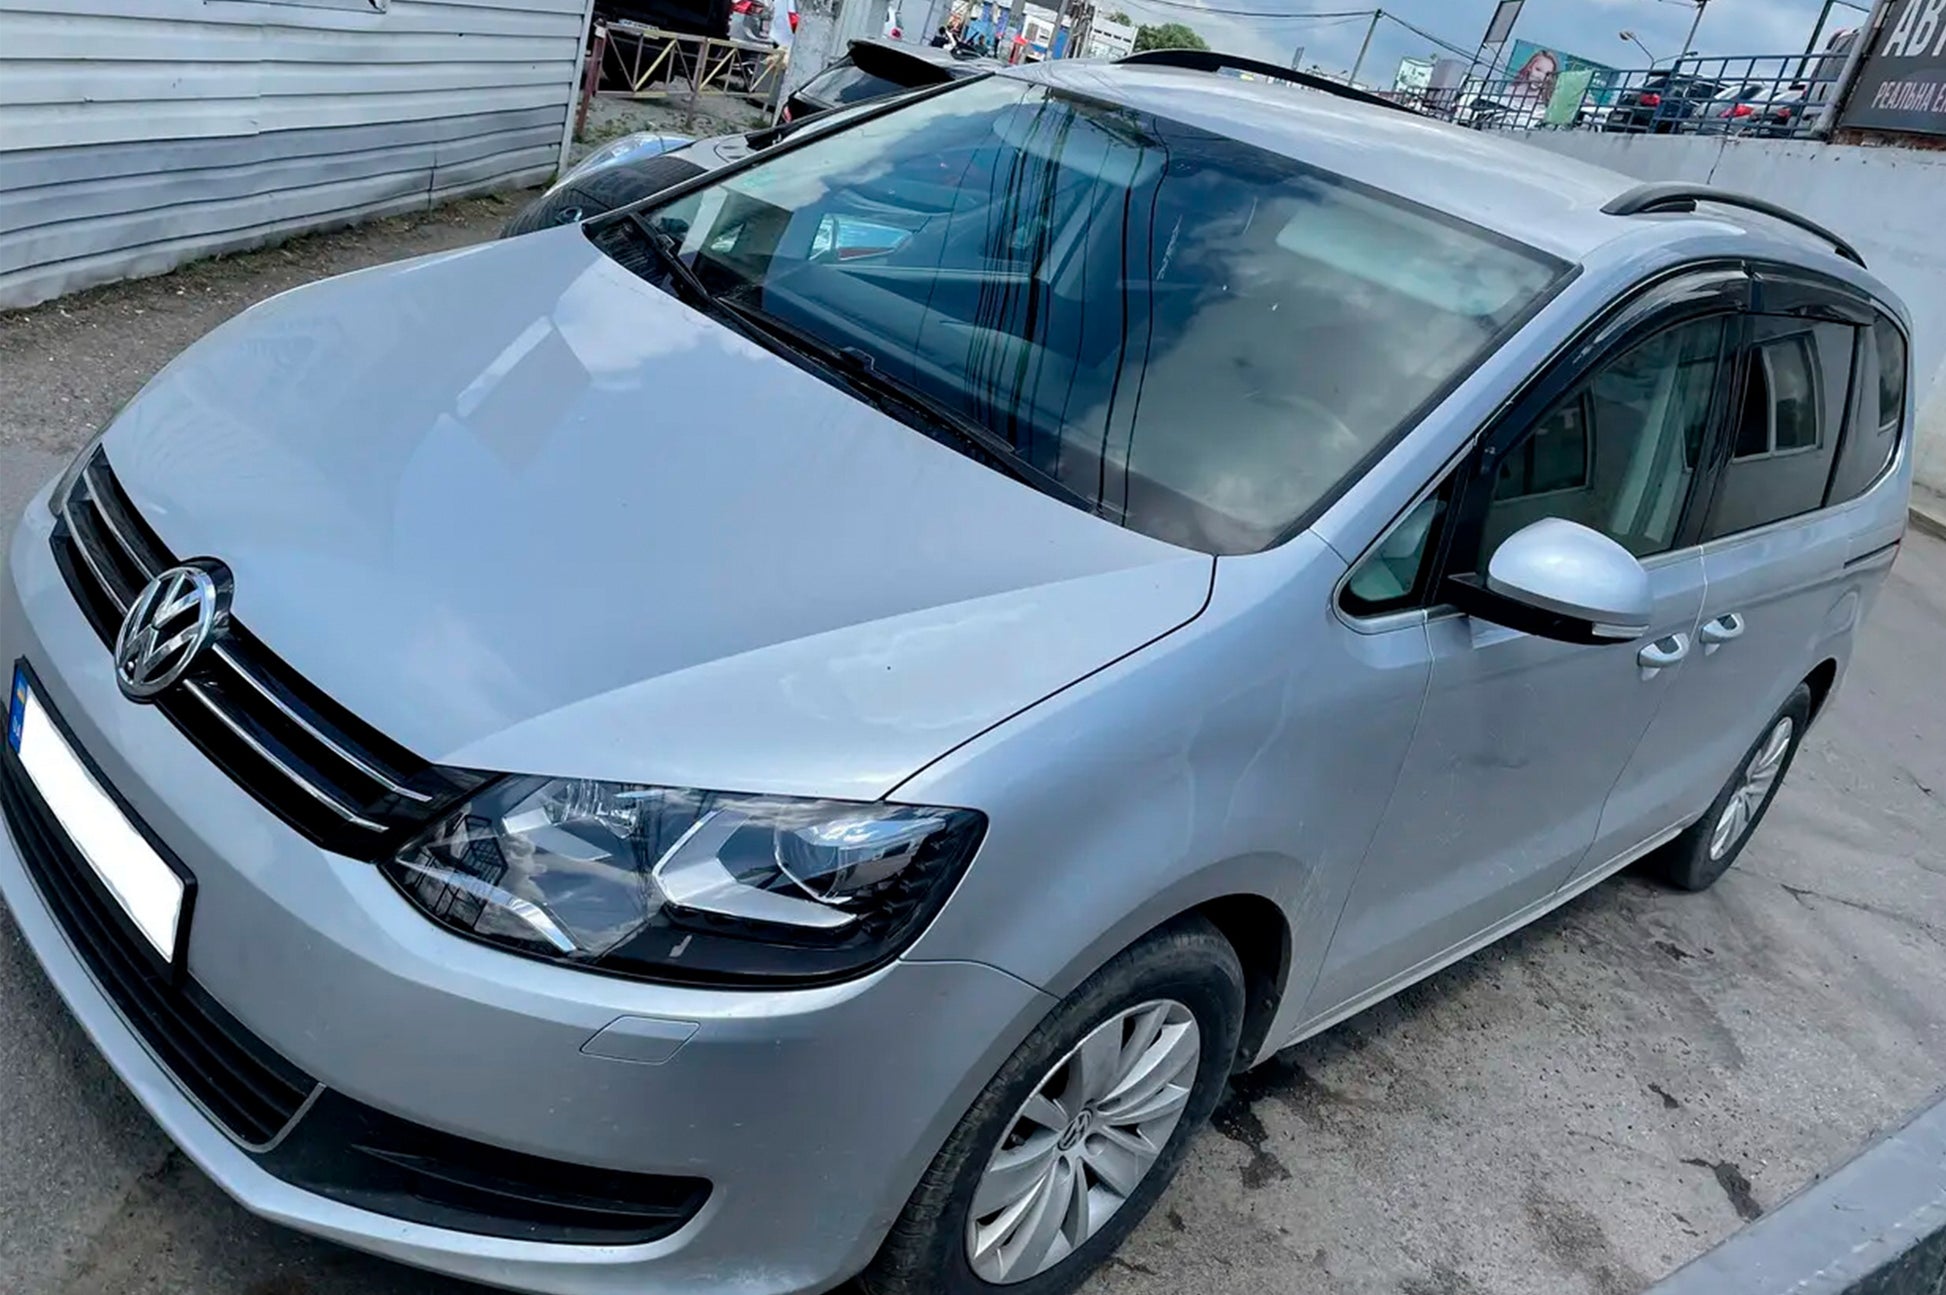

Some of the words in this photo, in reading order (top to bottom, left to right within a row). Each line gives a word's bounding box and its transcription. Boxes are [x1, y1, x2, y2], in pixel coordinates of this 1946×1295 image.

[1881, 0, 1946, 57] АВ
[1871, 81, 1937, 111] РЕАЛЬНА
[115, 566, 217, 696] VW
